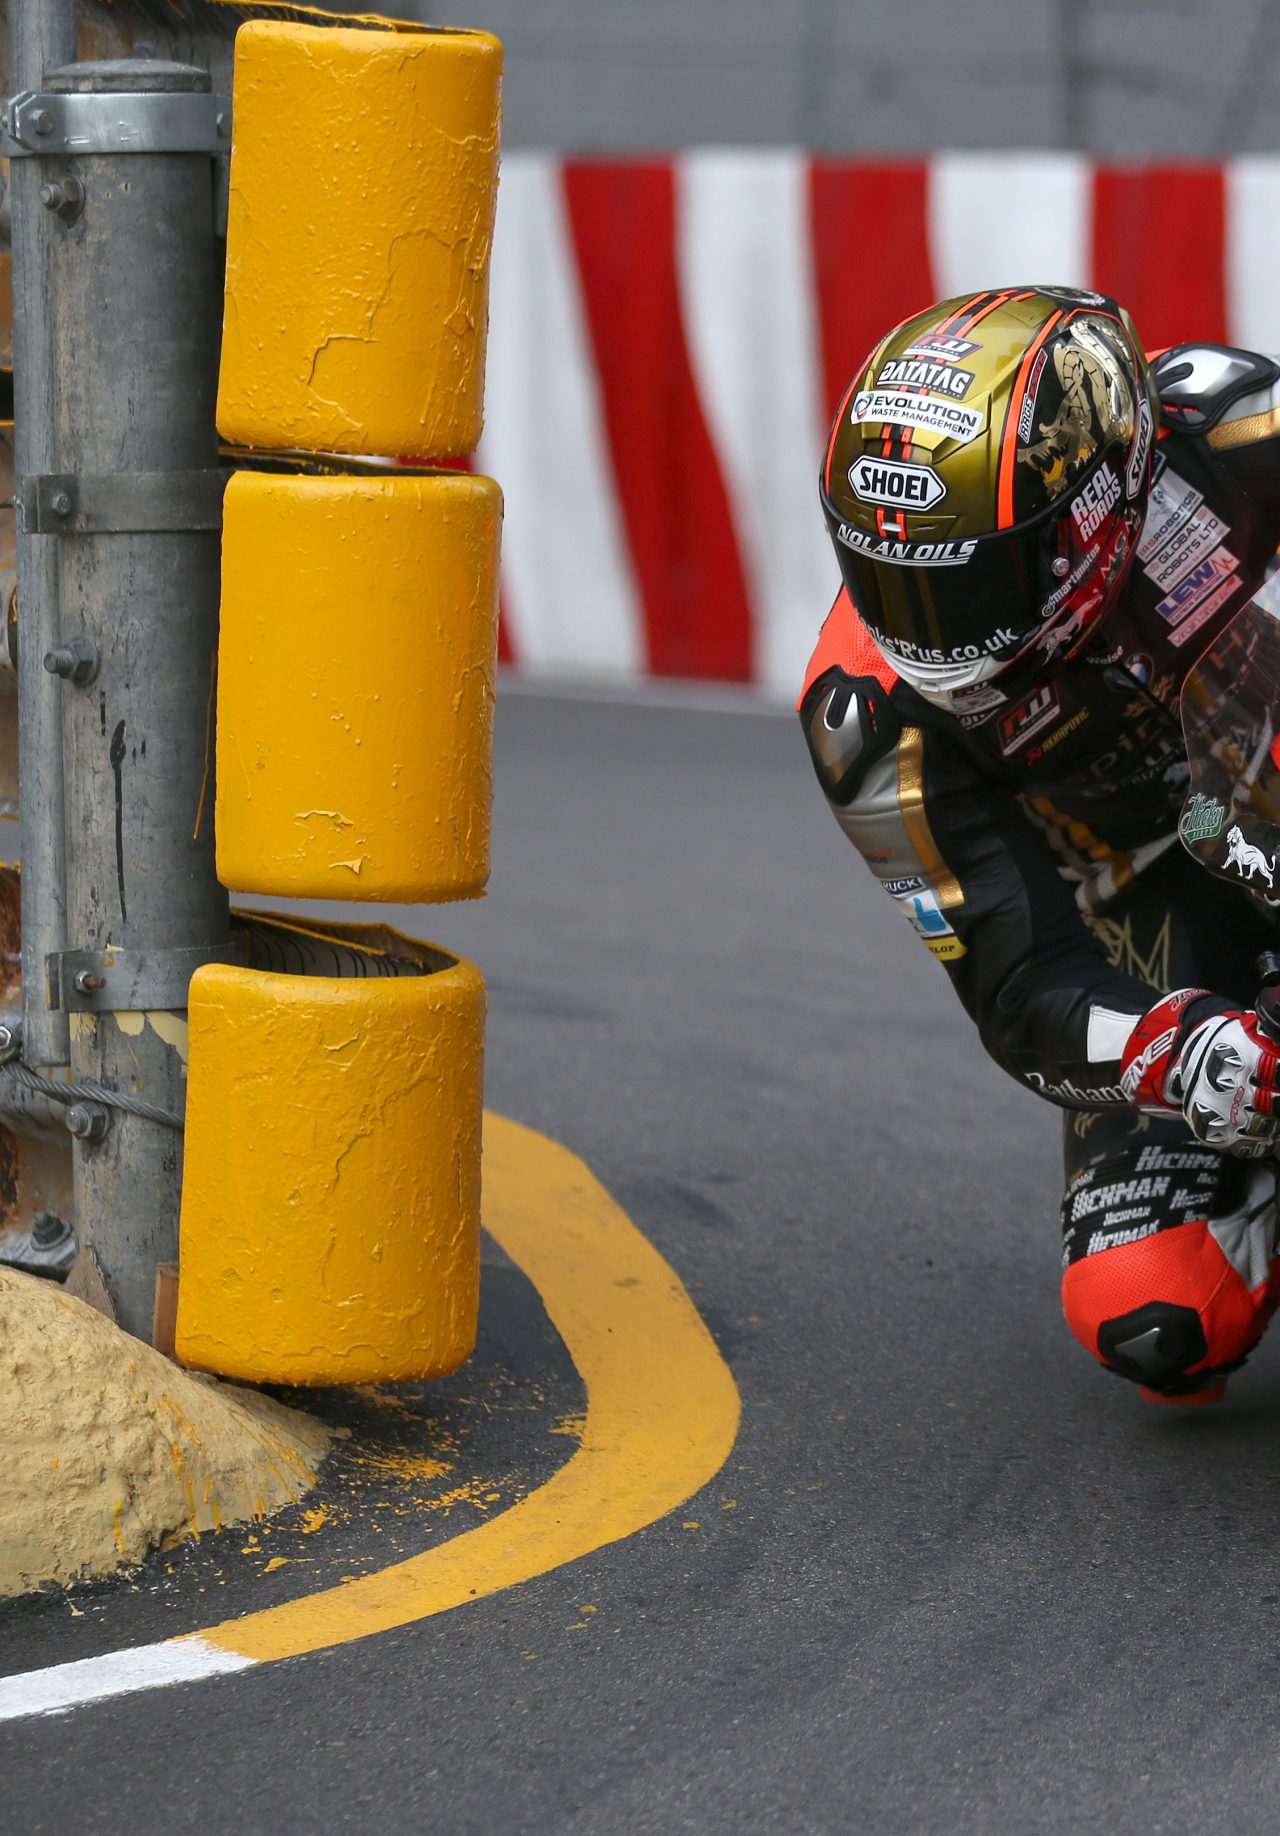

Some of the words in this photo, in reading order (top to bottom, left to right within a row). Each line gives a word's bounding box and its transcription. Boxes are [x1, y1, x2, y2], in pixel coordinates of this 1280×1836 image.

[879, 361, 970, 394] DATATAG
[871, 408, 899, 417] WASTE
[901, 411, 972, 436] MANAGEMENT
[874, 396, 977, 427] EVOLUTION
[859, 466, 928, 502] SHOEI
[1071, 461, 1116, 526] REAL
[1080, 478, 1121, 542] ROADS
[839, 524, 911, 558] NOLAN
[914, 539, 978, 560] OILS
[1157, 539, 1200, 583] ROBOTS
[1199, 518, 1219, 540] LTD
[1159, 522, 1200, 564] GLOBAL
[1157, 560, 1214, 618] LEW
[929, 945, 955, 954] LOP
[1121, 1027, 1178, 1096] FIVE
